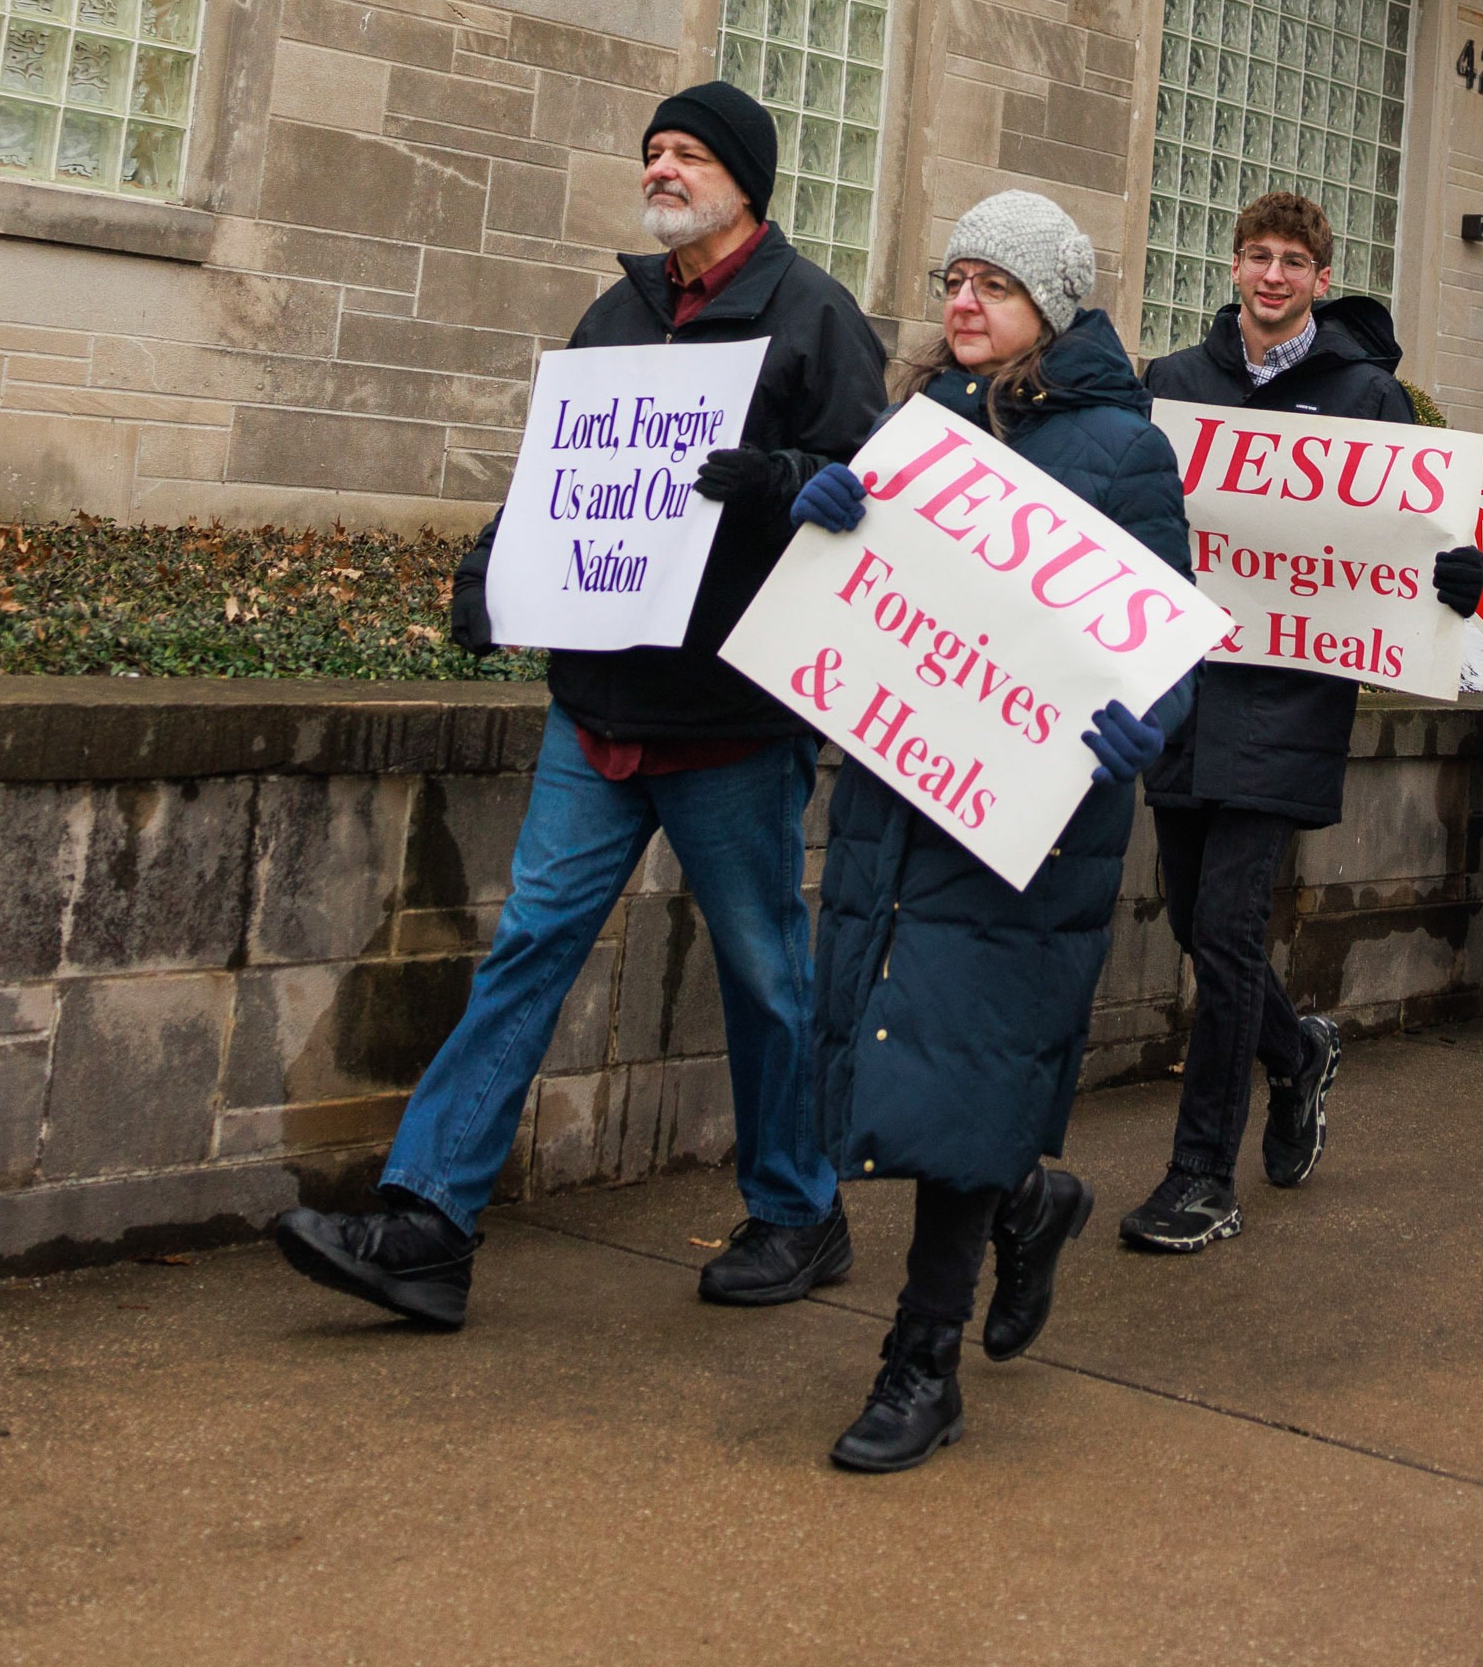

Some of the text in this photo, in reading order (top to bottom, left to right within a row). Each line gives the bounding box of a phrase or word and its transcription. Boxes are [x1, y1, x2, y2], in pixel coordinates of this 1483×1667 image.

[551, 395, 724, 463] Lord, Forgive
[550, 467, 694, 521] Us and Our
[1182, 417, 1453, 514] JESUS
[562, 539, 647, 593] Nation
[863, 427, 1185, 653] JESUS
[1194, 530, 1419, 600] Forgives
[834, 546, 1061, 744] Forgives
[1264, 612, 1404, 678] Heals
[790, 647, 997, 829] & Heals
